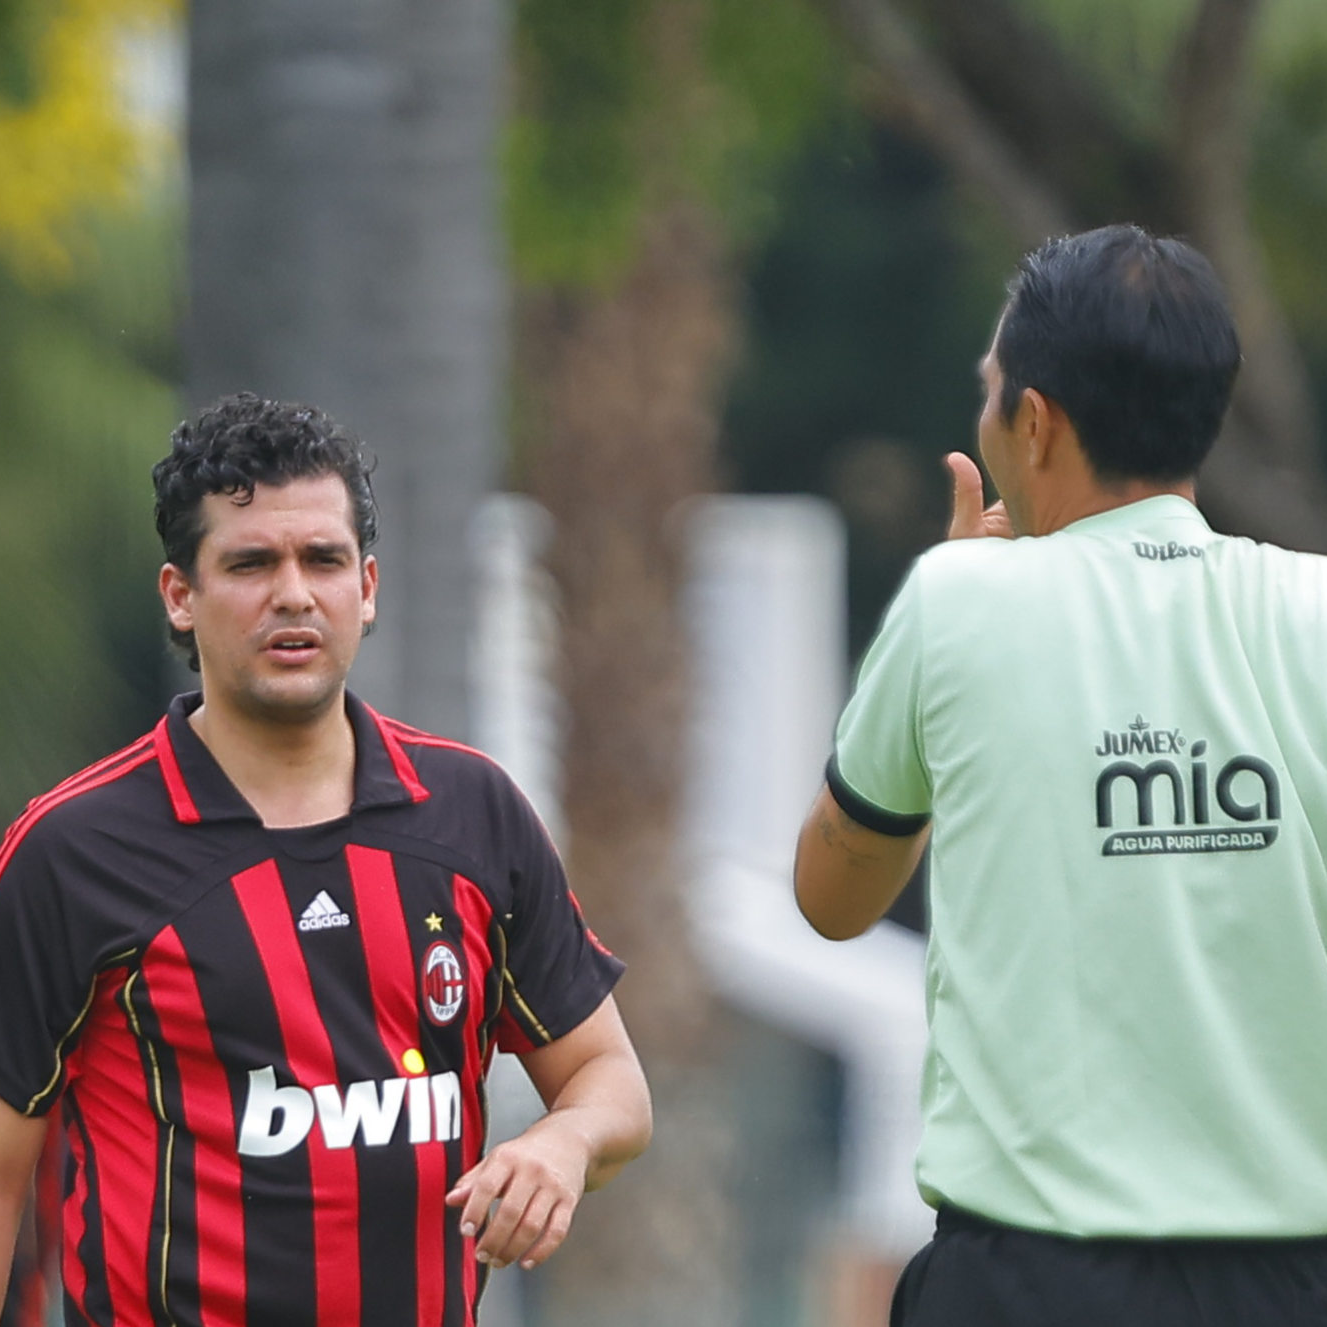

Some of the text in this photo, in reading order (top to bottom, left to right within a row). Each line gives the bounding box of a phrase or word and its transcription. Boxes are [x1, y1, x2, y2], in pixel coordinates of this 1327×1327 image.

[1131, 541, 1204, 561] Wilso
[1095, 729, 1181, 757] JUMEX
[1111, 832, 1266, 851] AGUA PURIFICADA
[298, 913, 351, 931] adidas
[237, 1048, 461, 1157] bwin
